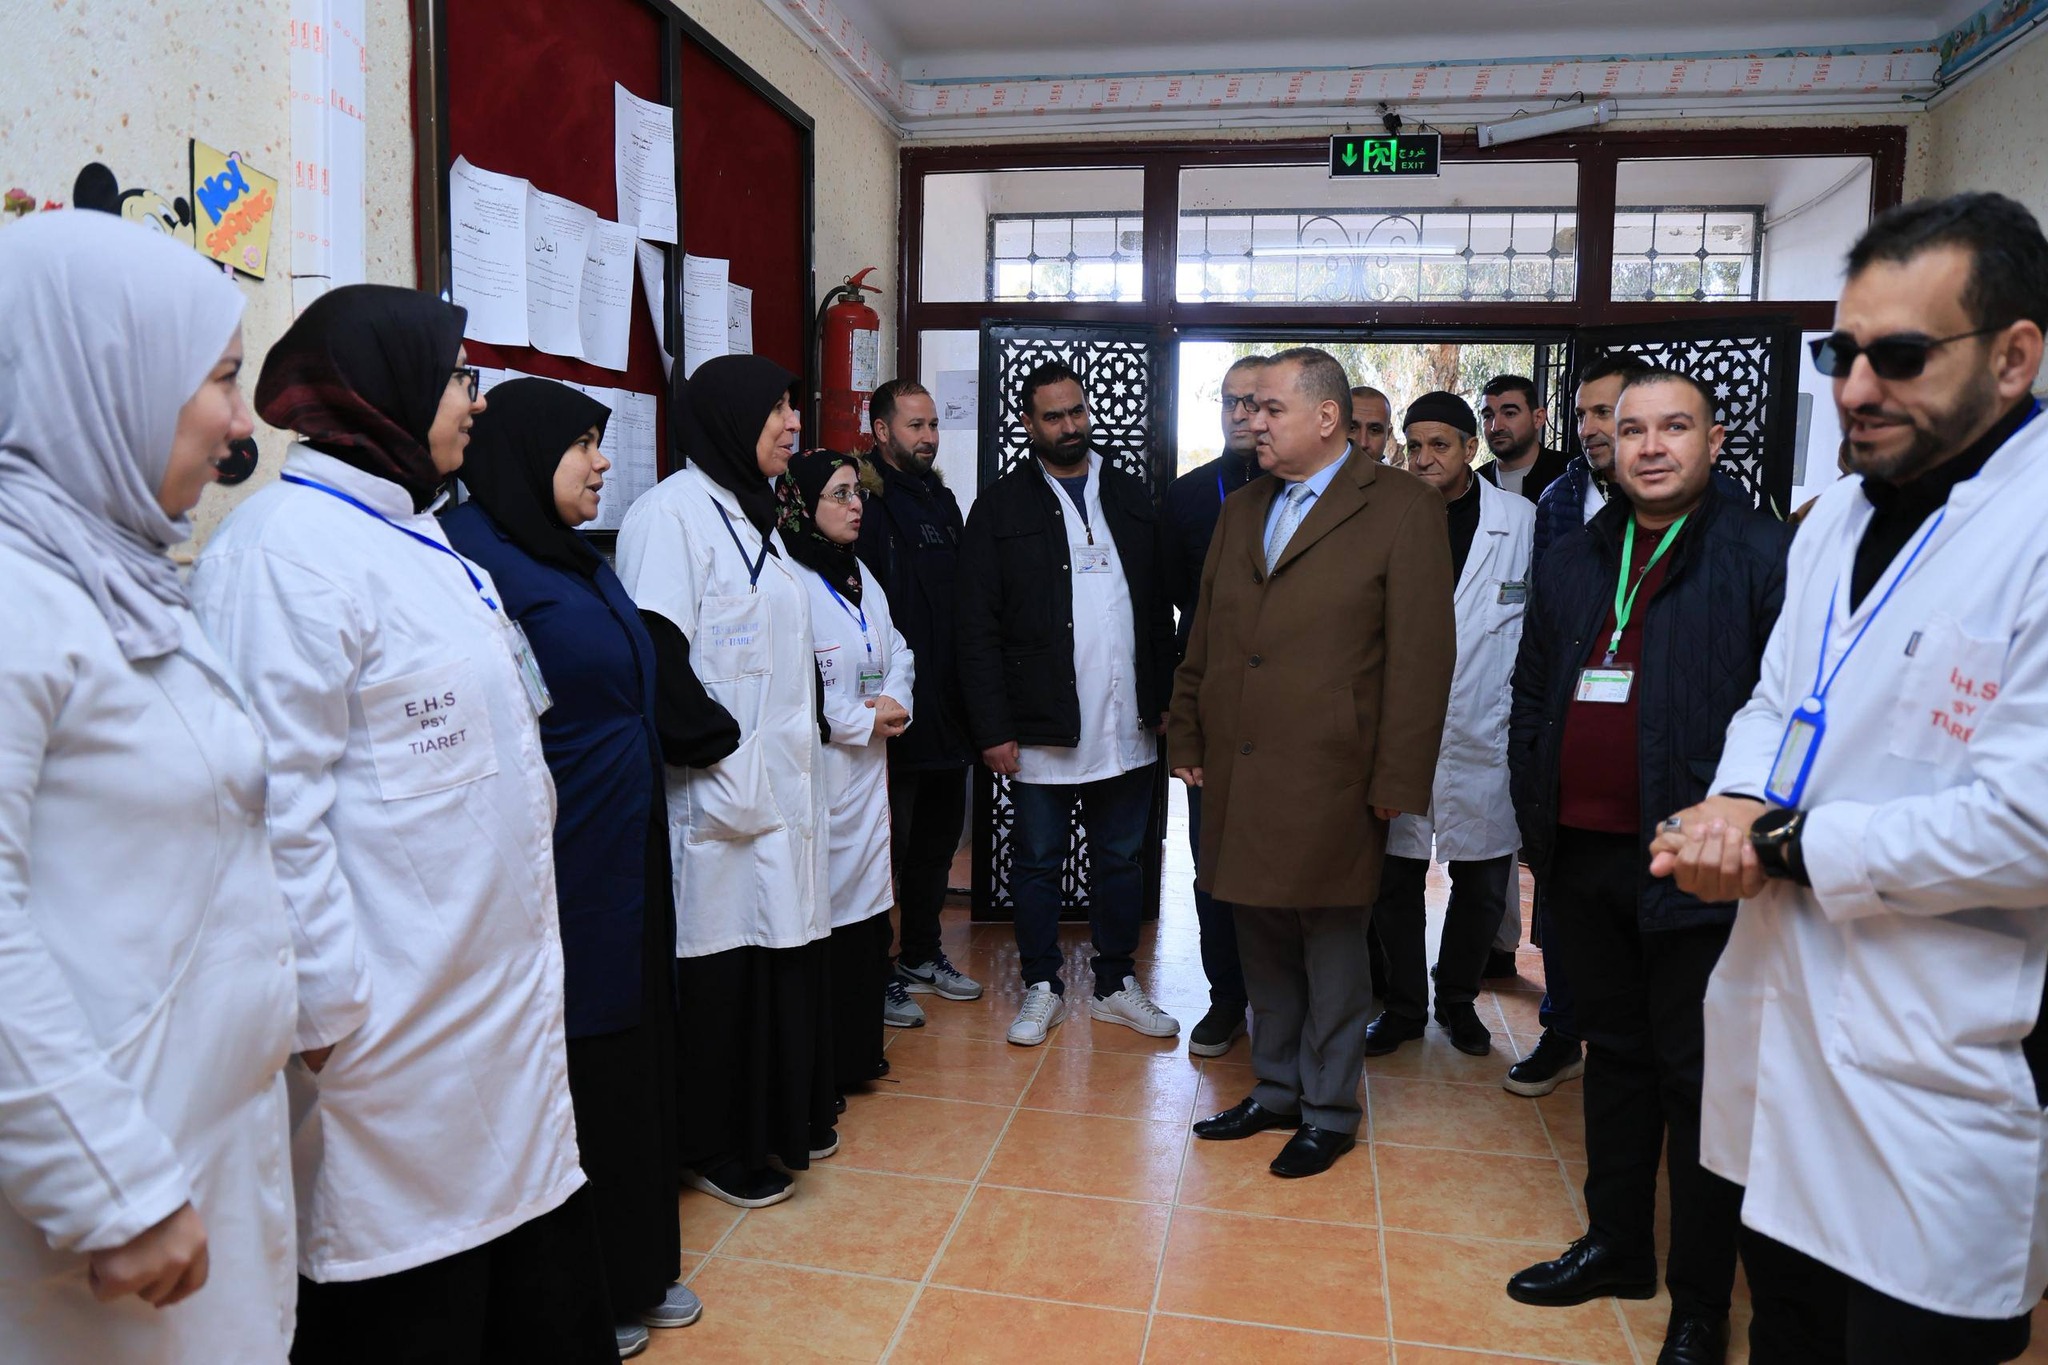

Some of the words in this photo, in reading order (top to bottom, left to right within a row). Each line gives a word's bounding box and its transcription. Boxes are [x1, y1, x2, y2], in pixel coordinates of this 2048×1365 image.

[1399, 147, 1426, 159] خروج
[1401, 161, 1425, 169] EXIT
[533, 235, 558, 259] إعلان
[404, 691, 456, 718] E.H.S
[420, 714, 448, 730] PSY
[408, 728, 466, 755] TIARET
